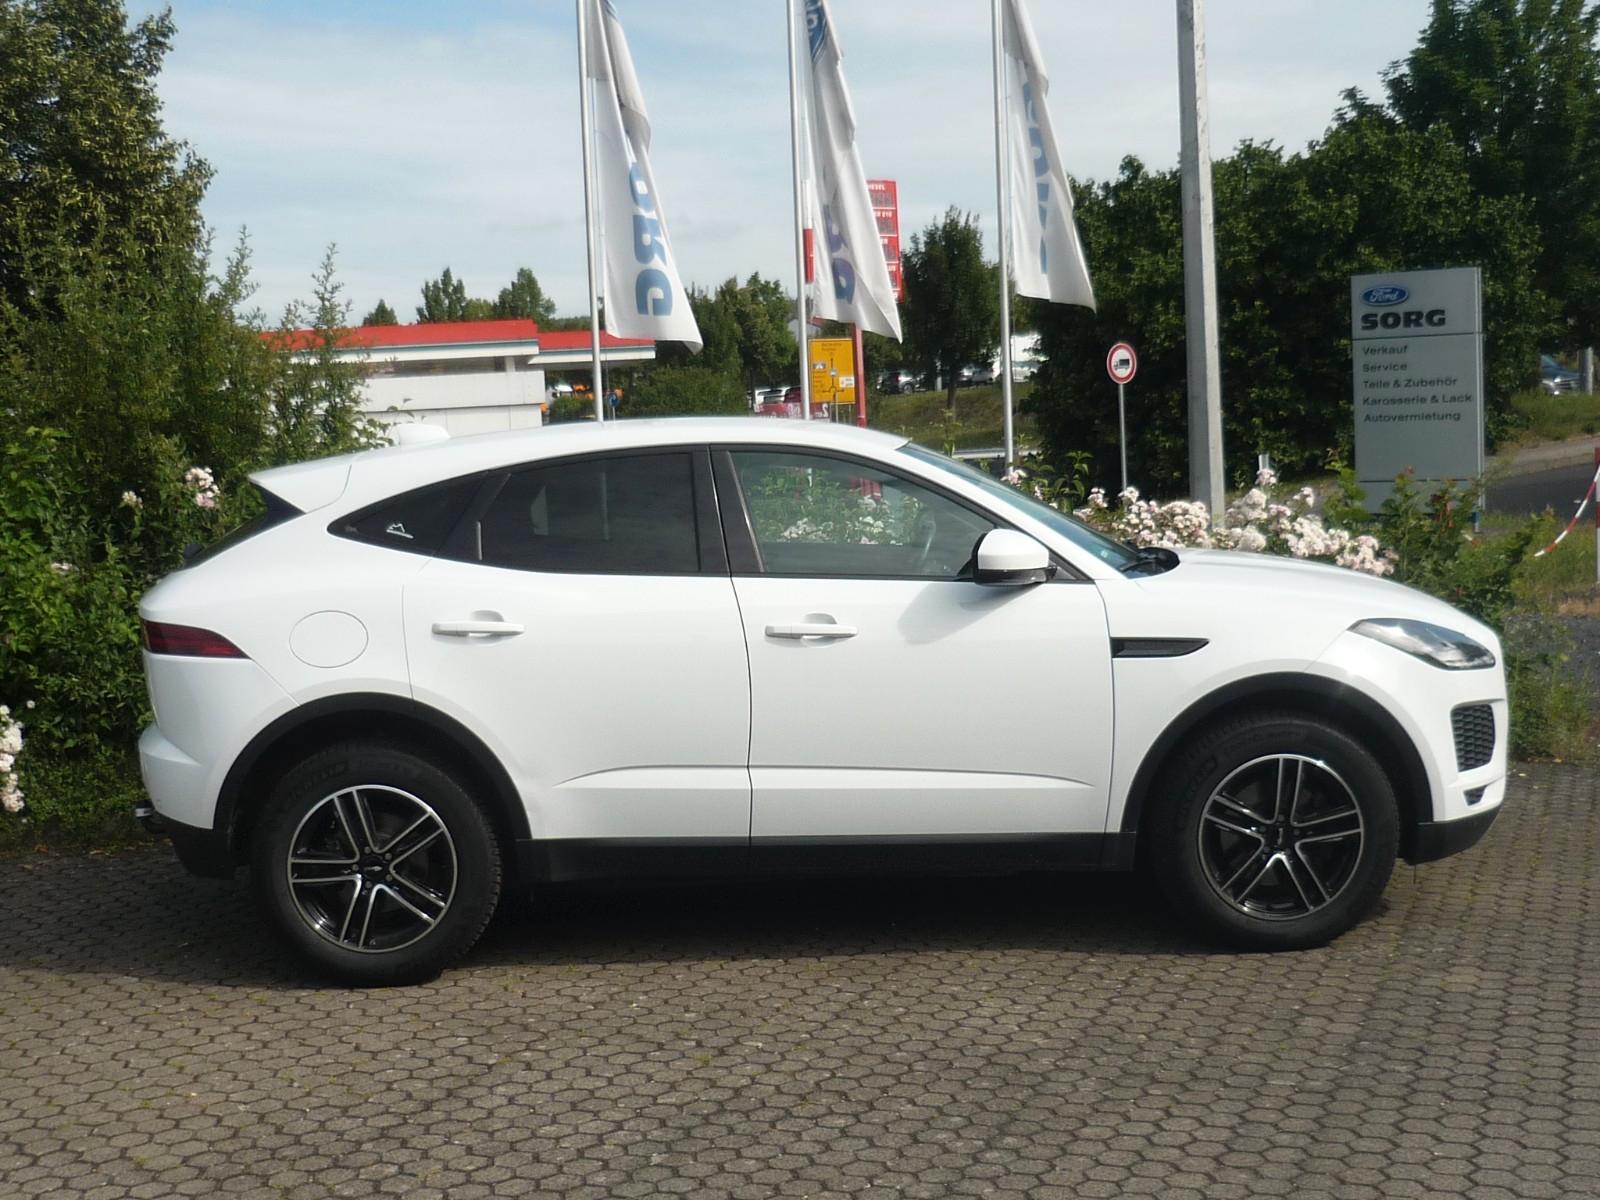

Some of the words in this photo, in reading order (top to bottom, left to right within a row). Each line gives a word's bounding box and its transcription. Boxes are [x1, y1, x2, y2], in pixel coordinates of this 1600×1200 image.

[1366, 287, 1402, 303] Ford
[1360, 309, 1446, 331] SORG
[1362, 345, 1408, 356] Verkauf
[1362, 363, 1408, 373] Service
[1363, 380, 1390, 389] Teile
[1393, 379, 1401, 388] &
[1404, 377, 1458, 388] Zubehör
[1362, 395, 1428, 406] Karosserie
[1431, 395, 1439, 404] &
[1442, 393, 1472, 404] Lack
[1363, 412, 1461, 424] Autovermietung
